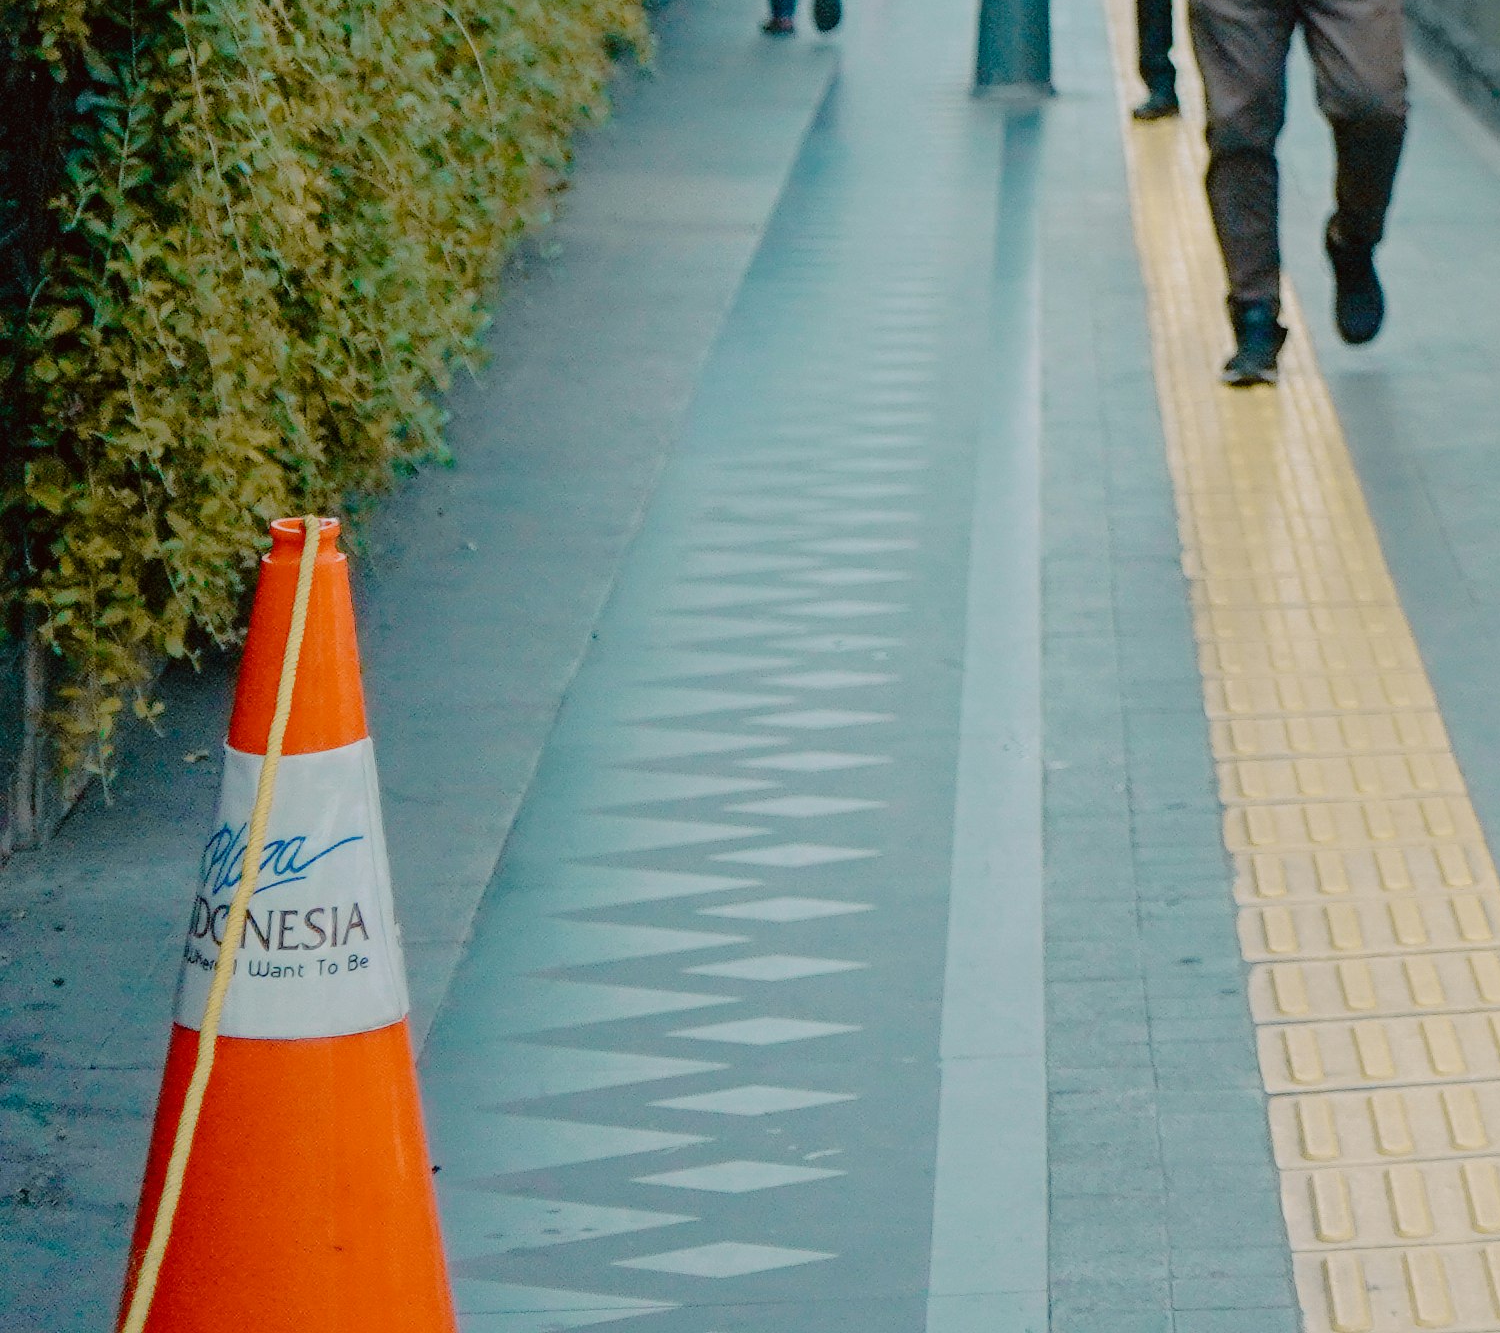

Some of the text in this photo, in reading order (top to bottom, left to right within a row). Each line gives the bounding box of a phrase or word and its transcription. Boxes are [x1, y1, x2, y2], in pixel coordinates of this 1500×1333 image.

[189, 893, 370, 952] DONESIA
[248, 957, 305, 978] Want
[316, 959, 338, 975] To
[347, 953, 369, 972] Be
